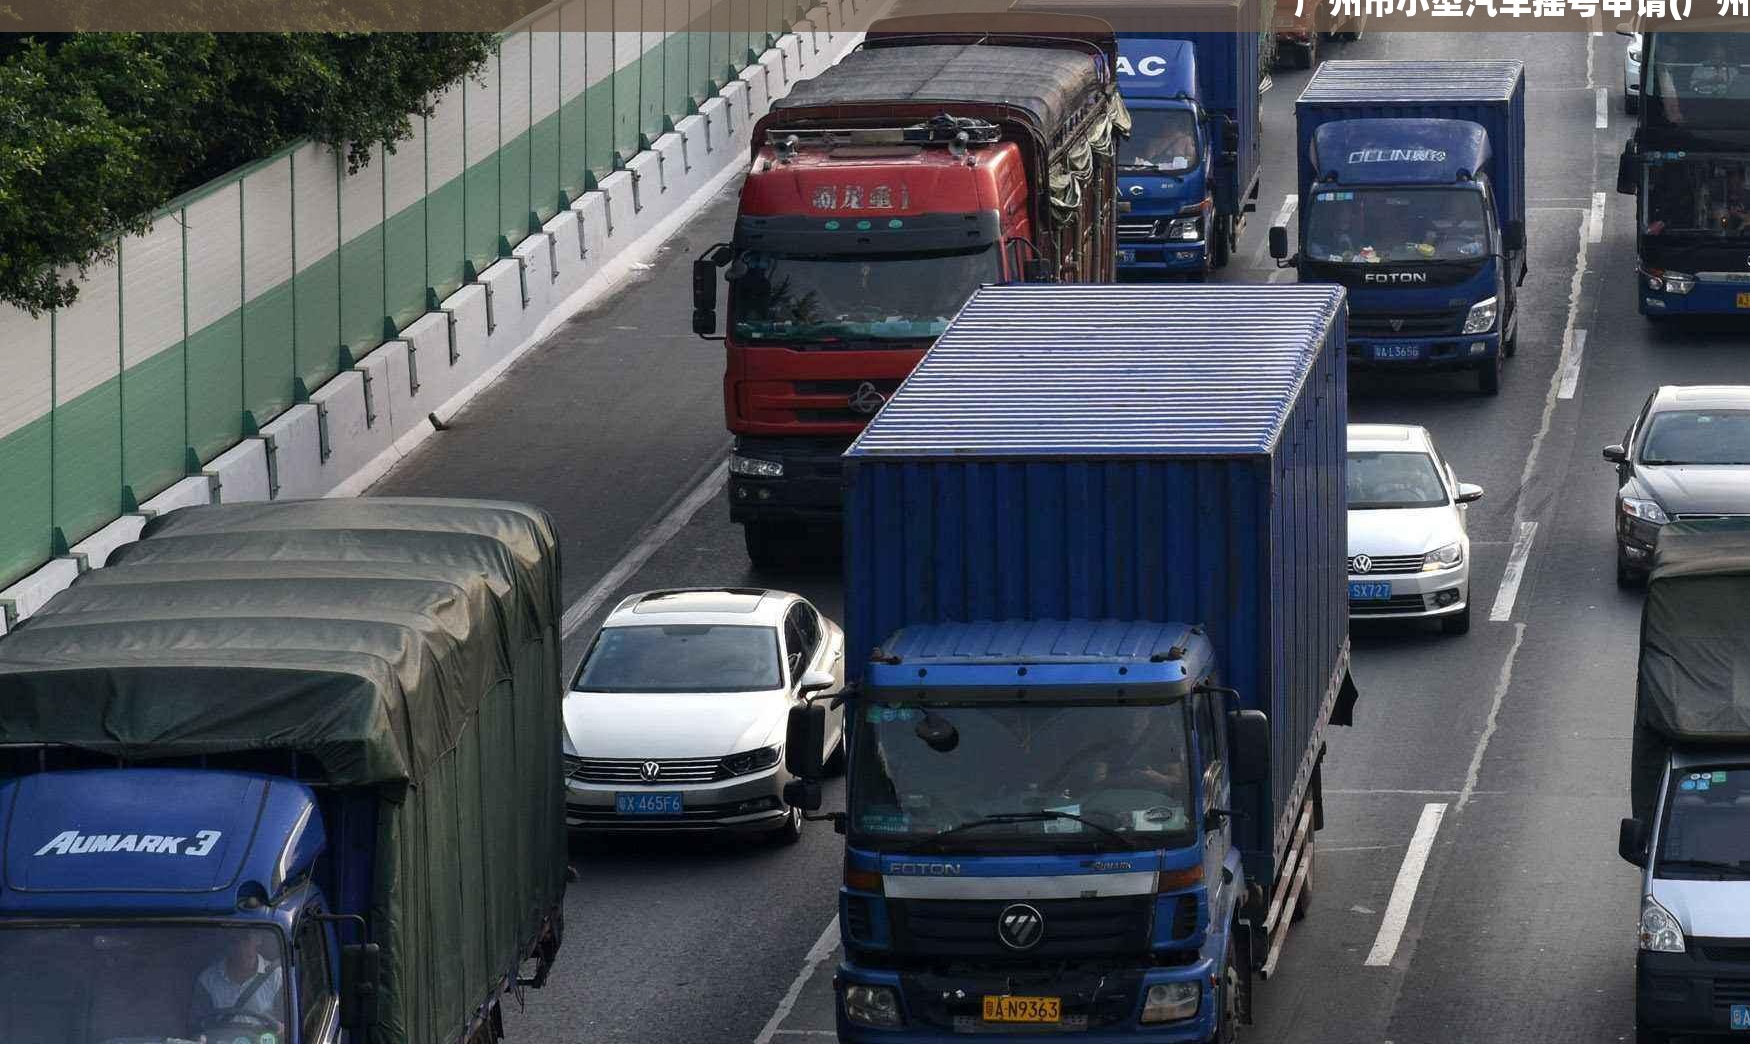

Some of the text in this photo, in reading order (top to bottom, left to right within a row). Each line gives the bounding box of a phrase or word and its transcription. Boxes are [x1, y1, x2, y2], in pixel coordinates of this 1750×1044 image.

[1116, 56, 1167, 76] AC
[1364, 272, 1427, 283] FOTON
[34, 830, 222, 857] AUMARK 3
[890, 863, 960, 874] FOTON
